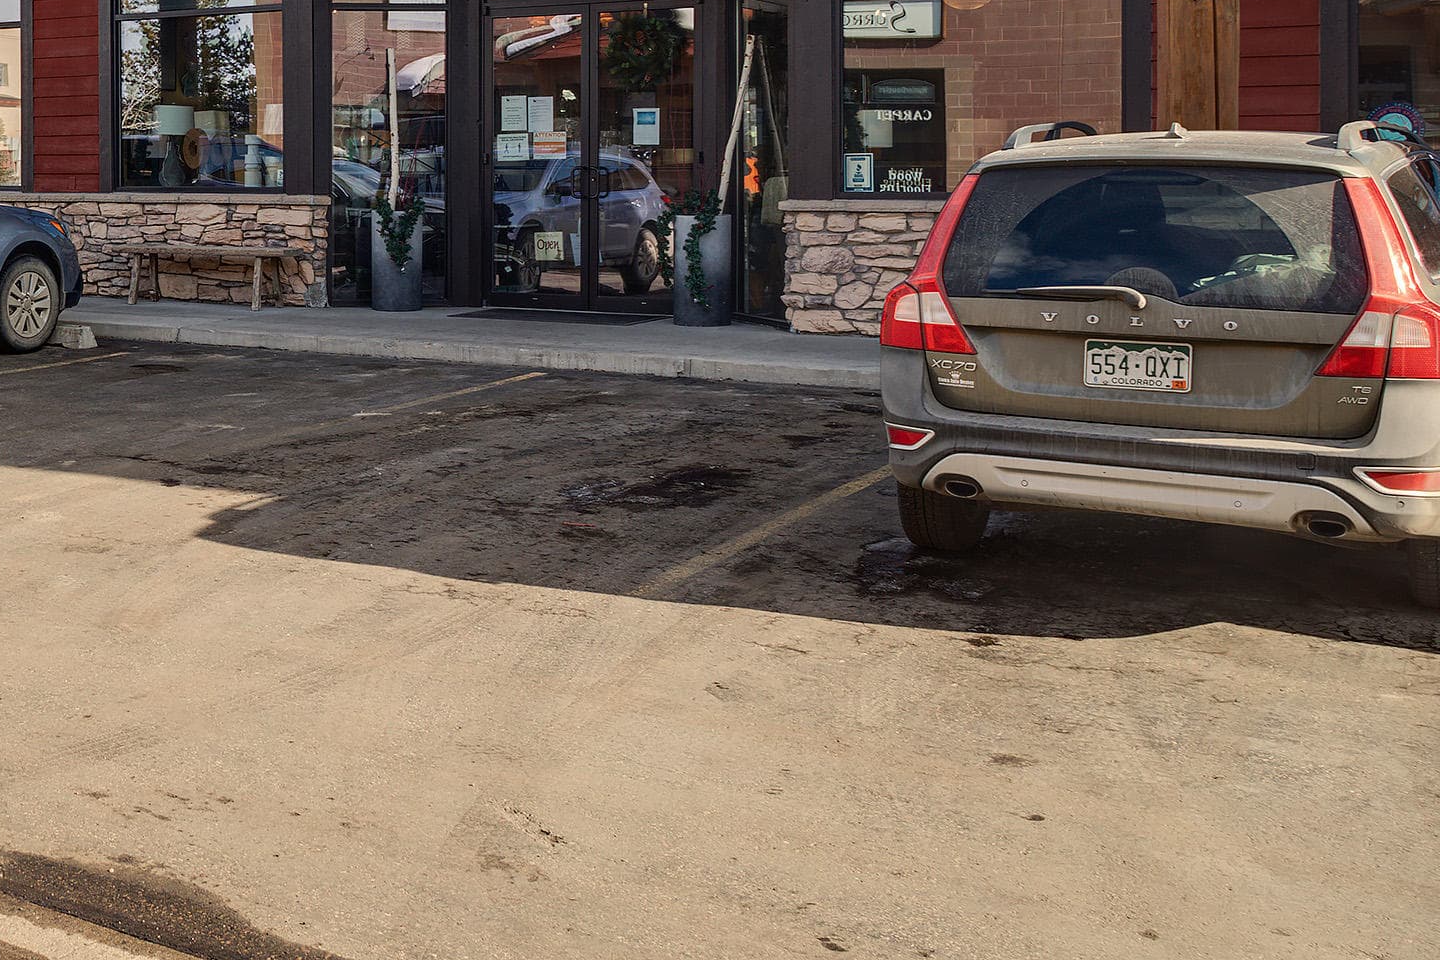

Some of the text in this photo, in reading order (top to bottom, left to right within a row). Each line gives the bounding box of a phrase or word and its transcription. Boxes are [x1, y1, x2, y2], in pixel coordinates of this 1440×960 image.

[537, 239, 559, 256] Open
[1040, 312, 1238, 331] VOLVO
[931, 358, 977, 372] XC70
[1111, 377, 1163, 387] COLORADO
[1337, 396, 1369, 405] AWD
